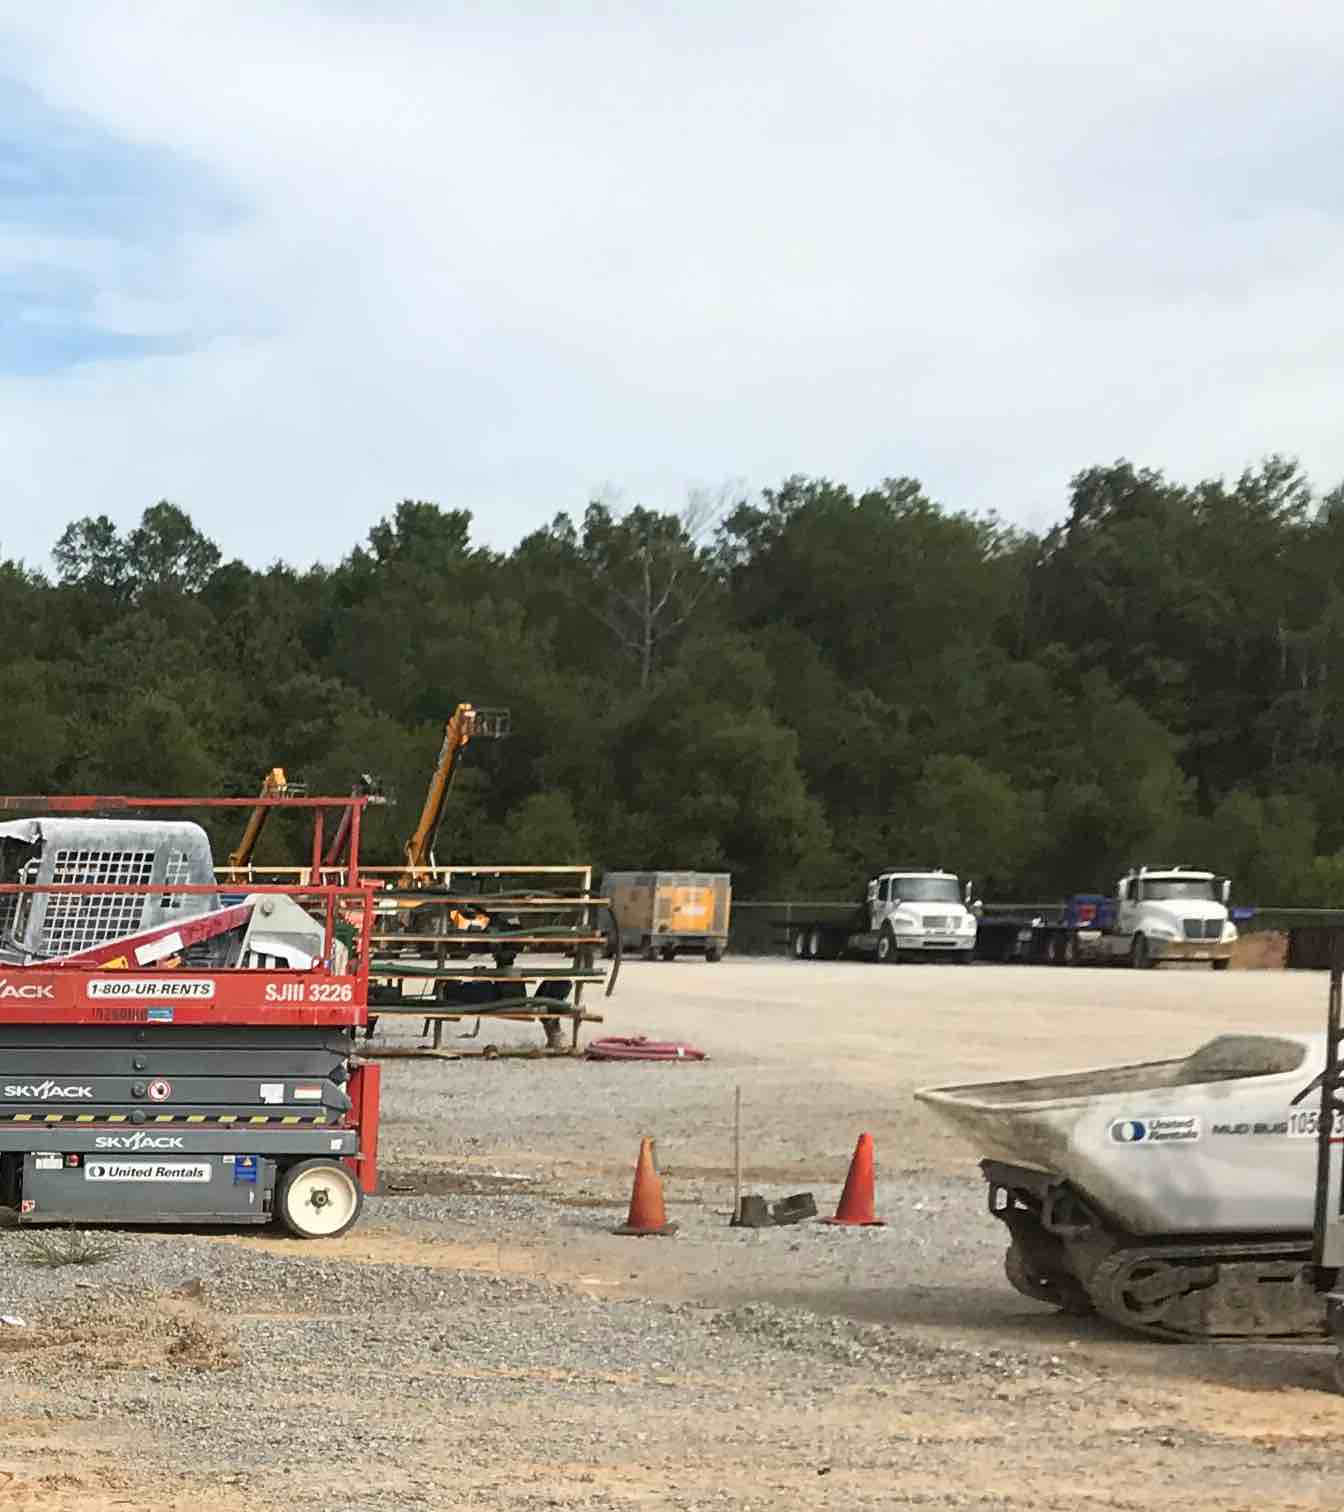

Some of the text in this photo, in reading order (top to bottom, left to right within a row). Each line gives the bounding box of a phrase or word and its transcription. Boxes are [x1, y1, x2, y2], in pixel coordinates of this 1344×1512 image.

[91, 983, 211, 996] 1-800-UR-RENTS
[308, 984, 352, 1002] 3226
[4, 1081, 93, 1099] SKYJACK
[1149, 1118, 1195, 1129] United
[95, 1132, 184, 1149] SKYJACK
[1149, 1130, 1198, 1141] Rentals
[108, 1166, 204, 1178] United Rentals
